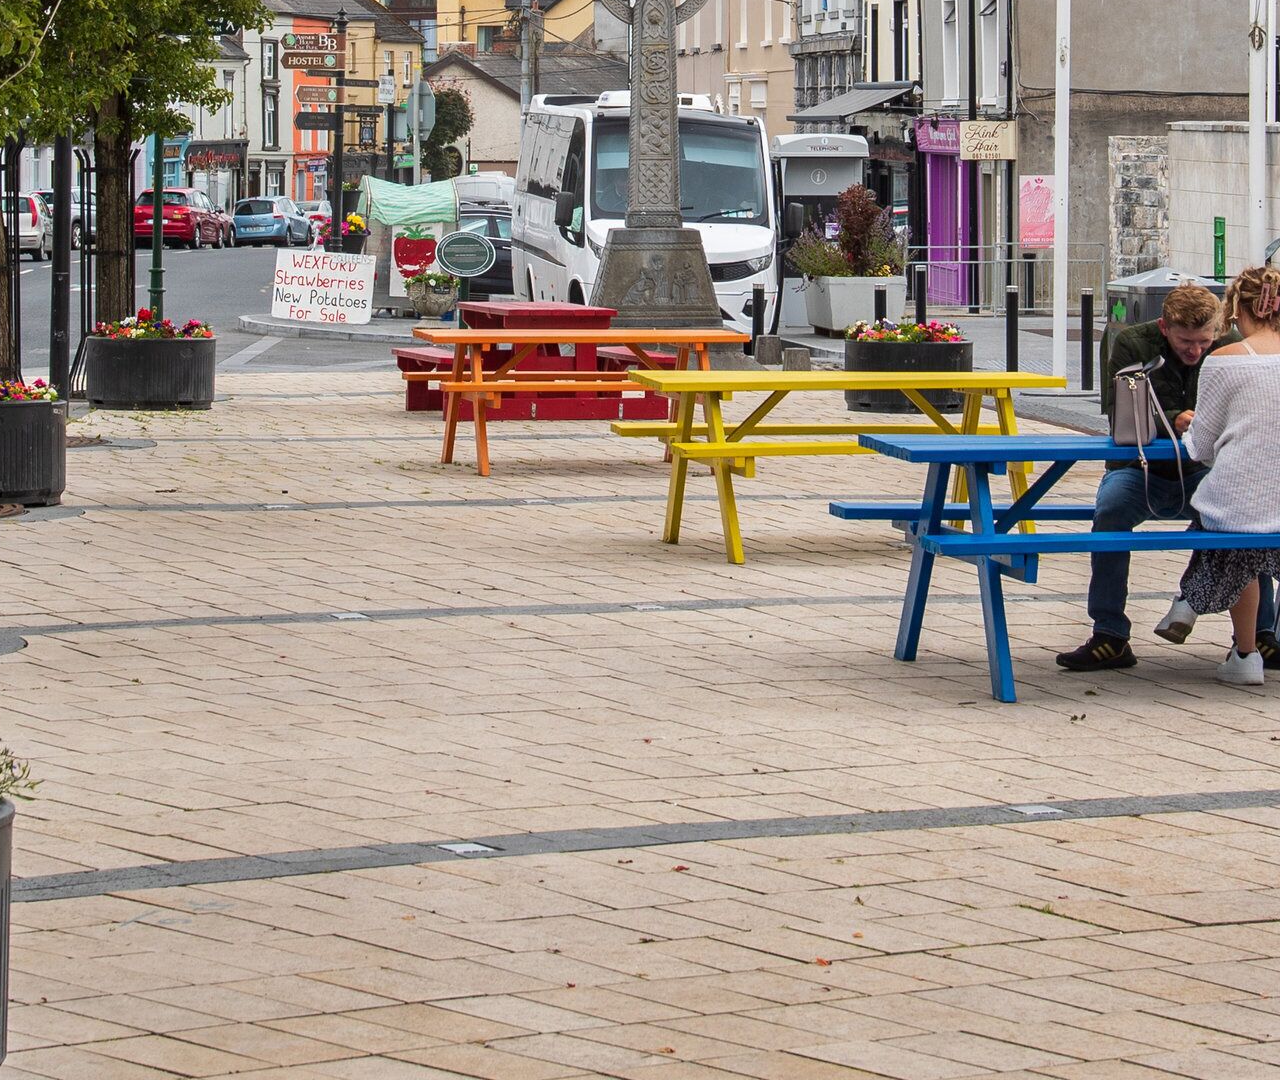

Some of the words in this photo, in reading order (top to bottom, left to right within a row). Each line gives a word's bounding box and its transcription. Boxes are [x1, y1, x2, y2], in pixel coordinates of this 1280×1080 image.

[288, 56, 324, 66] HOSTEL
[964, 122, 1009, 140] Kink
[966, 138, 1000, 153] Hair
[276, 270, 364, 291] Strawberries
[275, 288, 301, 303] New
[310, 290, 367, 308] Potatoes
[289, 305, 311, 319] For
[320, 308, 346, 322] Sale
